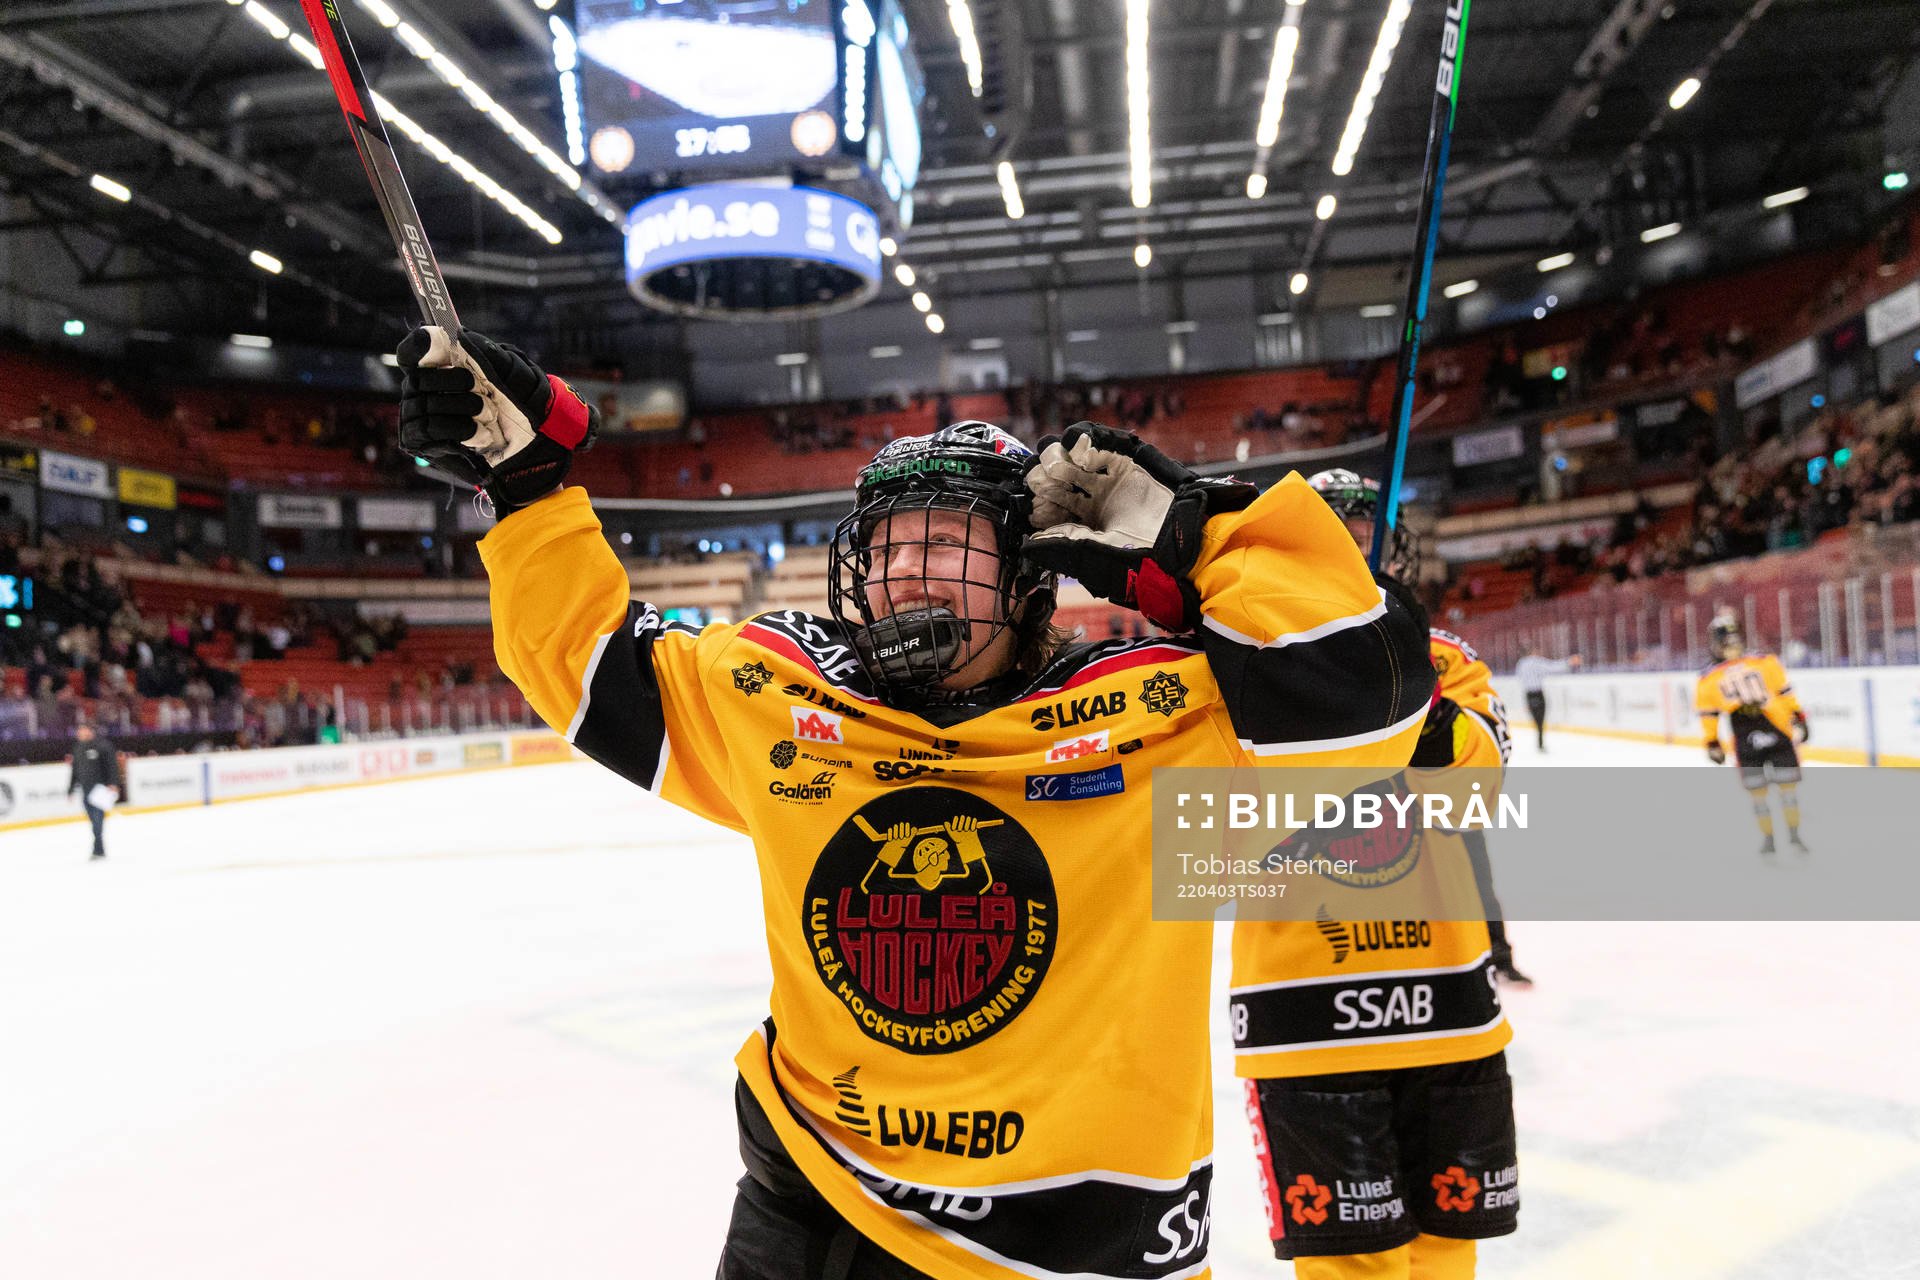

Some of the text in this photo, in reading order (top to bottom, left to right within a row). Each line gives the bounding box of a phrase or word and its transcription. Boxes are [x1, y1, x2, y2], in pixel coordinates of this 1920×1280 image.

[1056, 691, 1127, 728] LKAB
[768, 780, 832, 800] Galären
[1069, 779, 1122, 795] Consulting
[1070, 771, 1106, 786] Student
[836, 882, 1017, 930] LULEÅ
[1353, 920, 1431, 951] LULEBO
[810, 897, 1048, 1047] LULEÅ HOCKEYFÖRENING 1977
[836, 931, 1015, 1015] HOCKEY
[1333, 984, 1434, 1031] SSAB
[877, 1104, 1025, 1159] LULEBO
